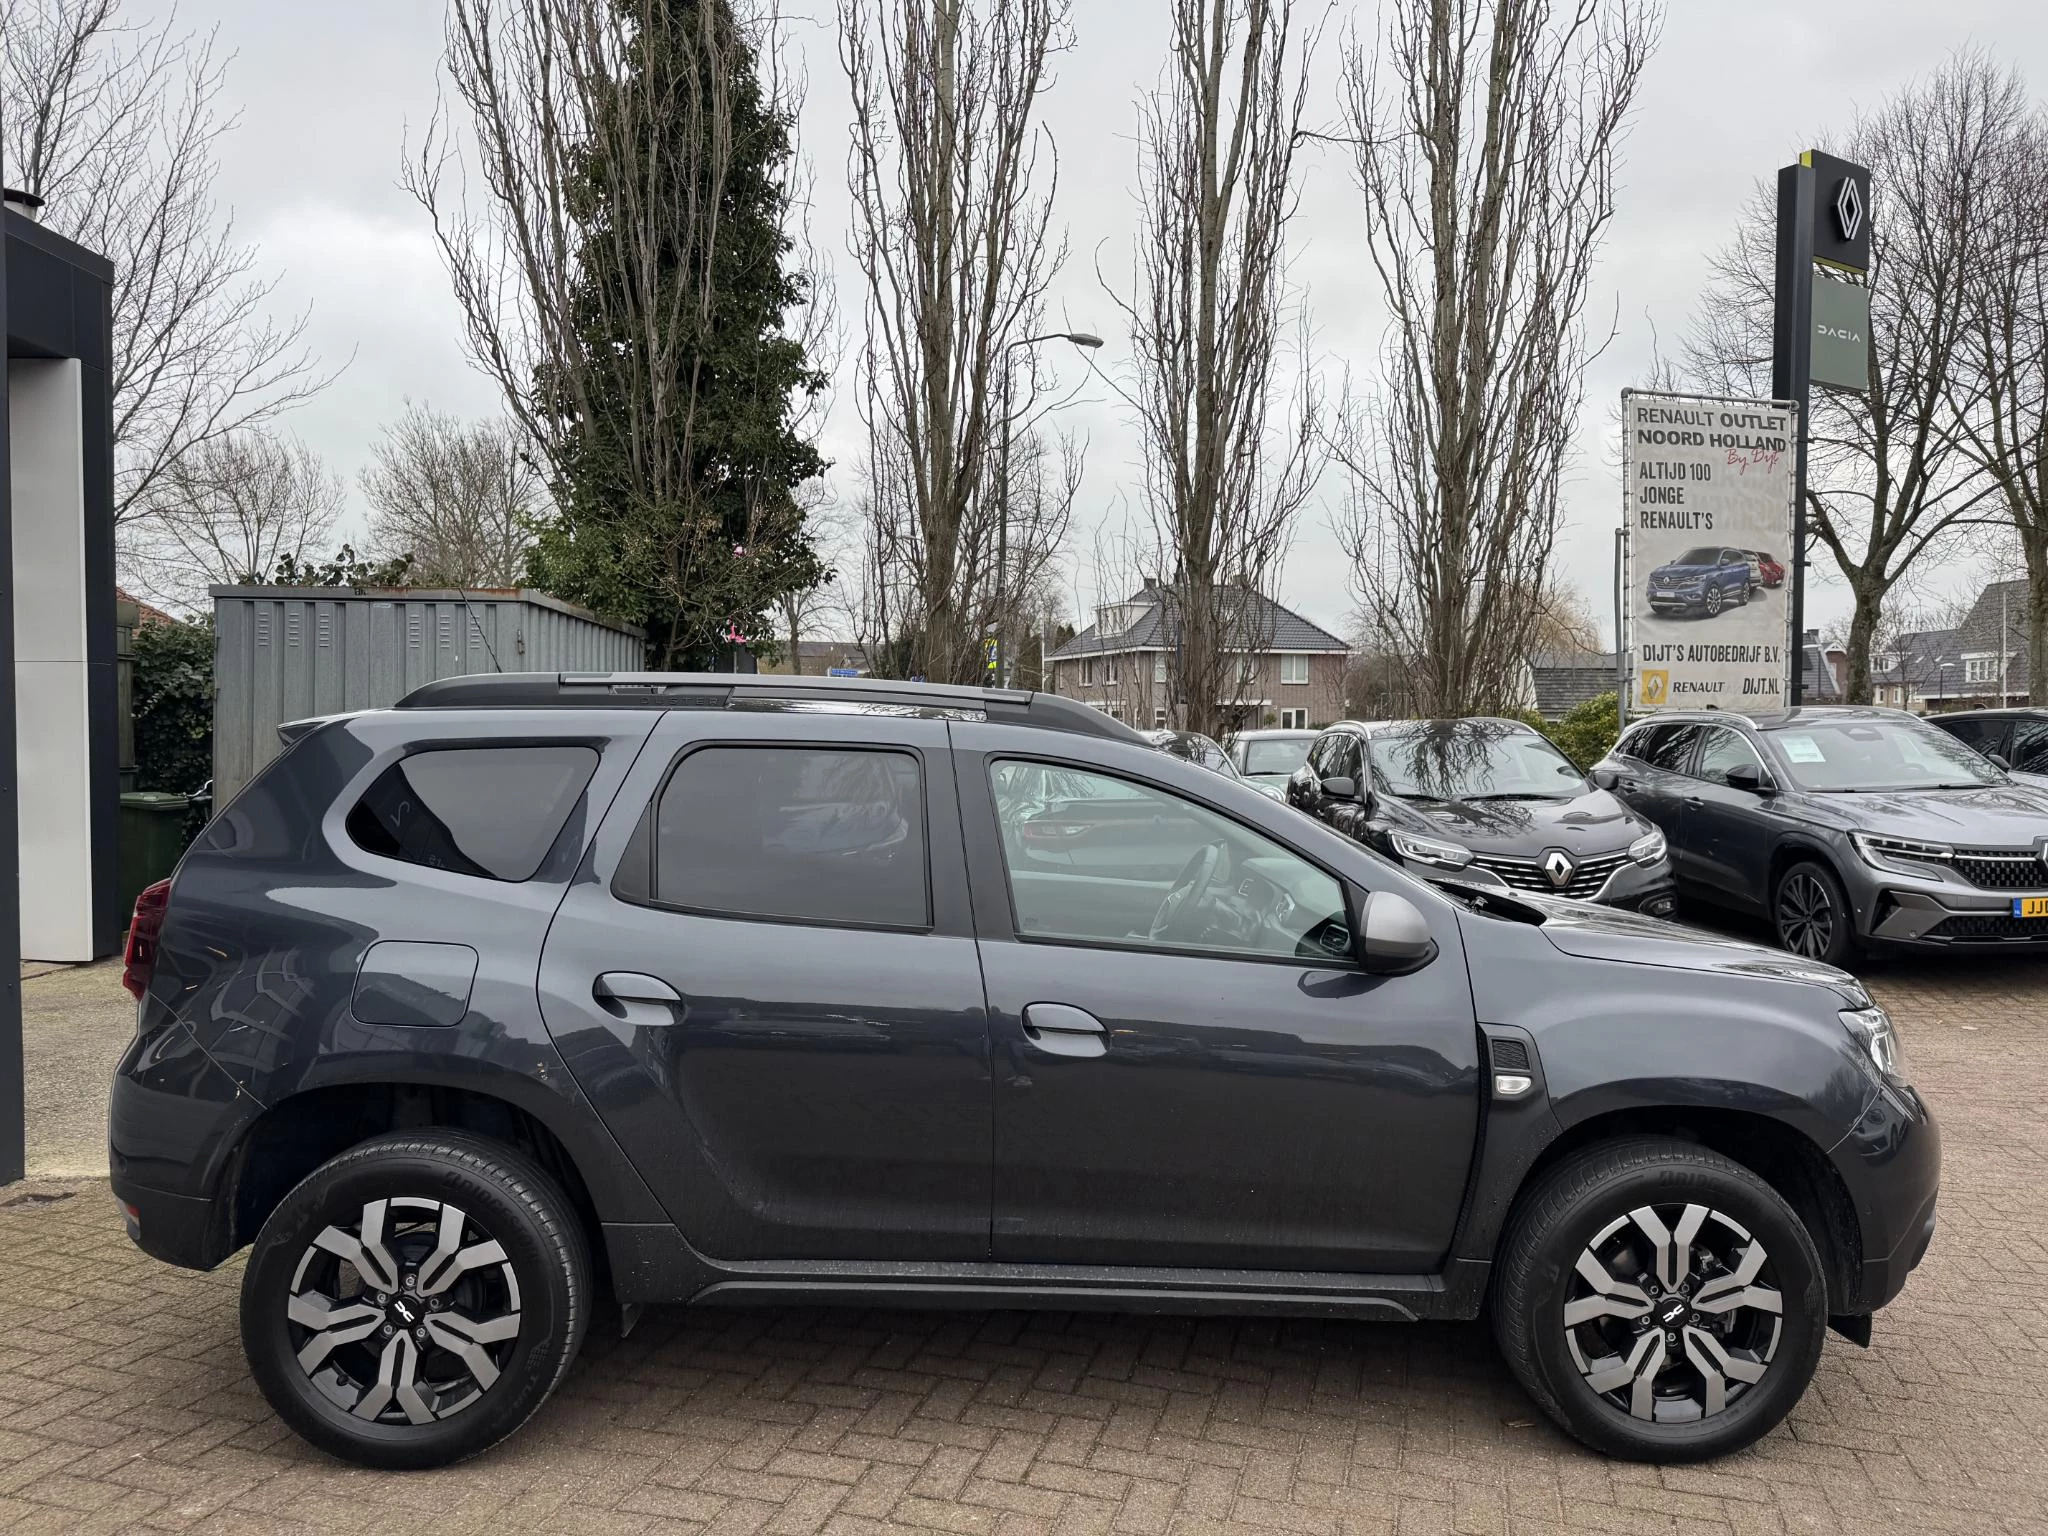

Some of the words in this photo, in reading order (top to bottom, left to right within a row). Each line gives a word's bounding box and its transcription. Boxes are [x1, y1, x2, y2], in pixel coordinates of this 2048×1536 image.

[1817, 324, 1861, 343] DACIA
[1637, 407, 1714, 426] RENAULT
[1720, 412, 1786, 431] OUTLET
[1638, 430, 1704, 446] NOORD
[1710, 433, 1786, 452] HOLLAND
[1639, 461, 1686, 480] ALTIJD
[1690, 463, 1711, 481] 100
[1724, 448, 1749, 475] By
[1640, 486, 1685, 504] JONGE
[1640, 511, 1713, 529] RENAULT'S
[1643, 644, 1684, 662] DIJT'S
[1687, 645, 1761, 663] AUTOBEDRIJF
[1764, 646, 1780, 663] B.V.
[1673, 681, 1725, 693] RENAULT
[1742, 677, 1780, 695] DIJT.NL
